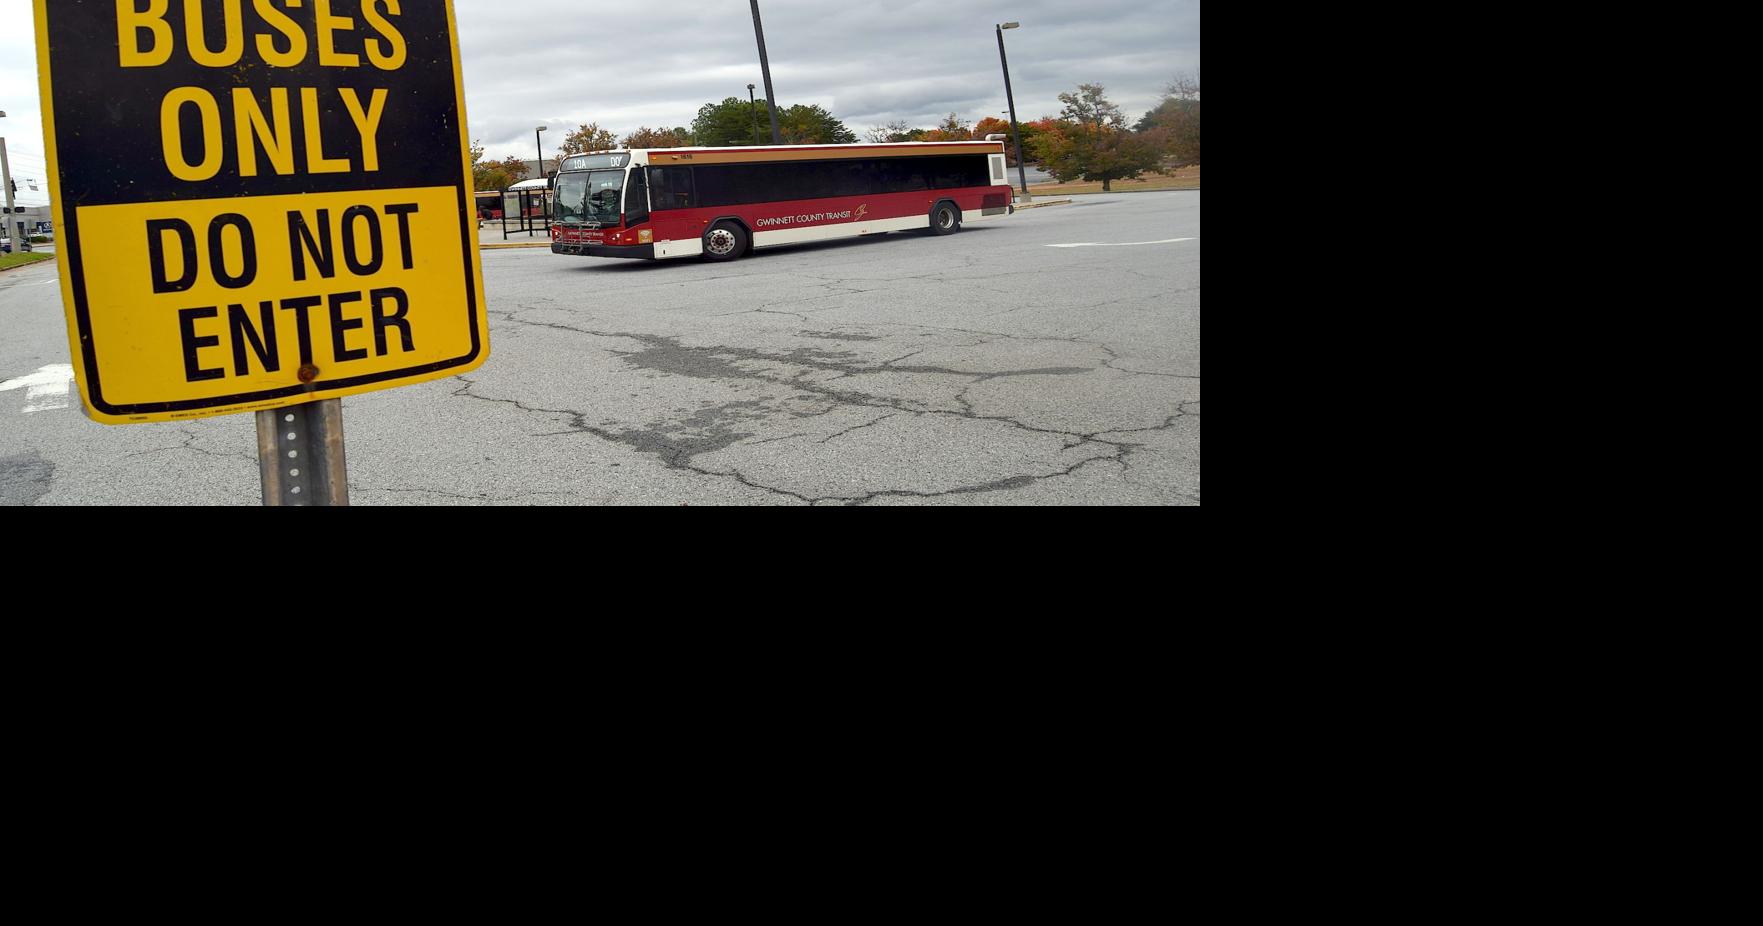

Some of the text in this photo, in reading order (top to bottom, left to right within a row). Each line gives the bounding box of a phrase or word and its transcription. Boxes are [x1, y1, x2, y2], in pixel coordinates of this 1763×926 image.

[116, 0, 406, 70] BUSES
[161, 87, 388, 181] ONLY
[146, 203, 418, 294] DO NOT
[756, 210, 851, 227] GWINNETT COUNTY TRANSIT
[179, 287, 415, 382] ENTER
